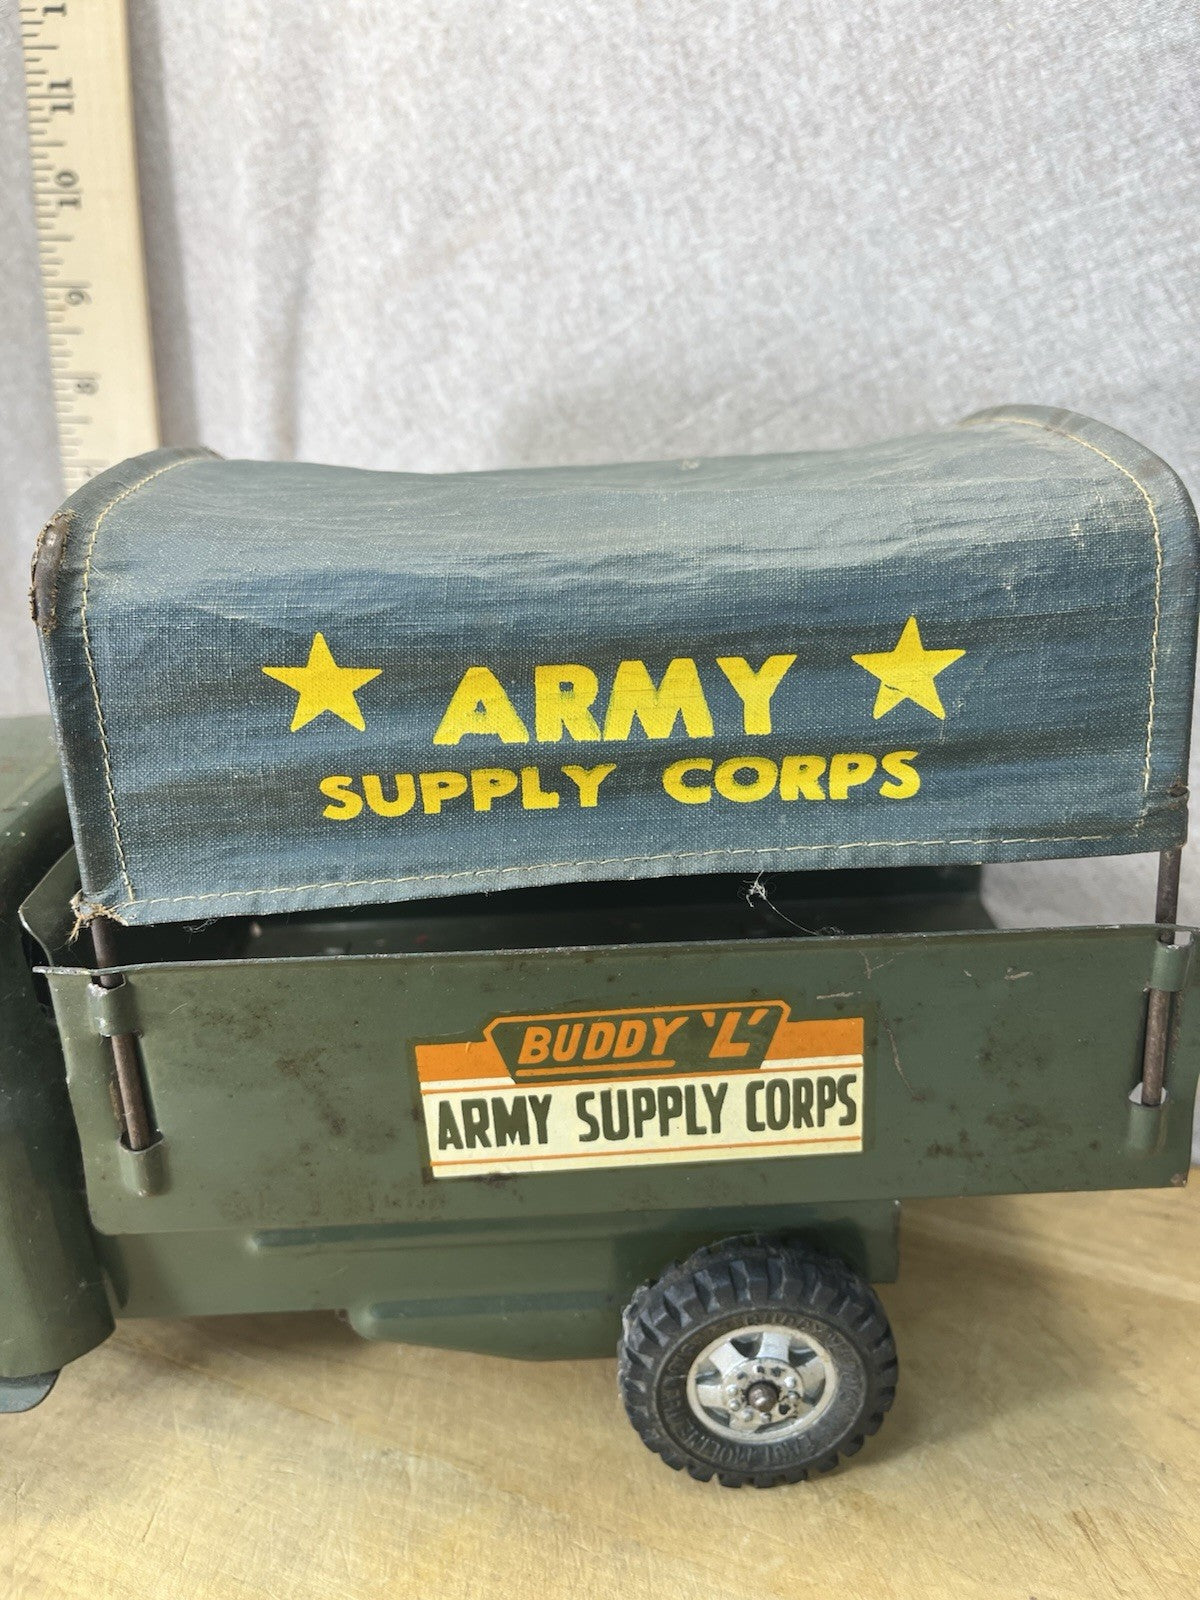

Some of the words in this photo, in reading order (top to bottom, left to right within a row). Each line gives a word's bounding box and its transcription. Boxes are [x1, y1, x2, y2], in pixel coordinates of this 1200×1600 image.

[47, 78, 75, 114] 11
[53, 169, 82, 209] 10
[434, 655, 796, 745] ARMY
[320, 764, 614, 819] SUPPLY
[663, 751, 918, 802] CORPS
[518, 1017, 687, 1064] BUDDY
[439, 1094, 551, 1150] ARMY
[576, 1083, 728, 1142] SUPPLY
[746, 1075, 856, 1132] CORPS
